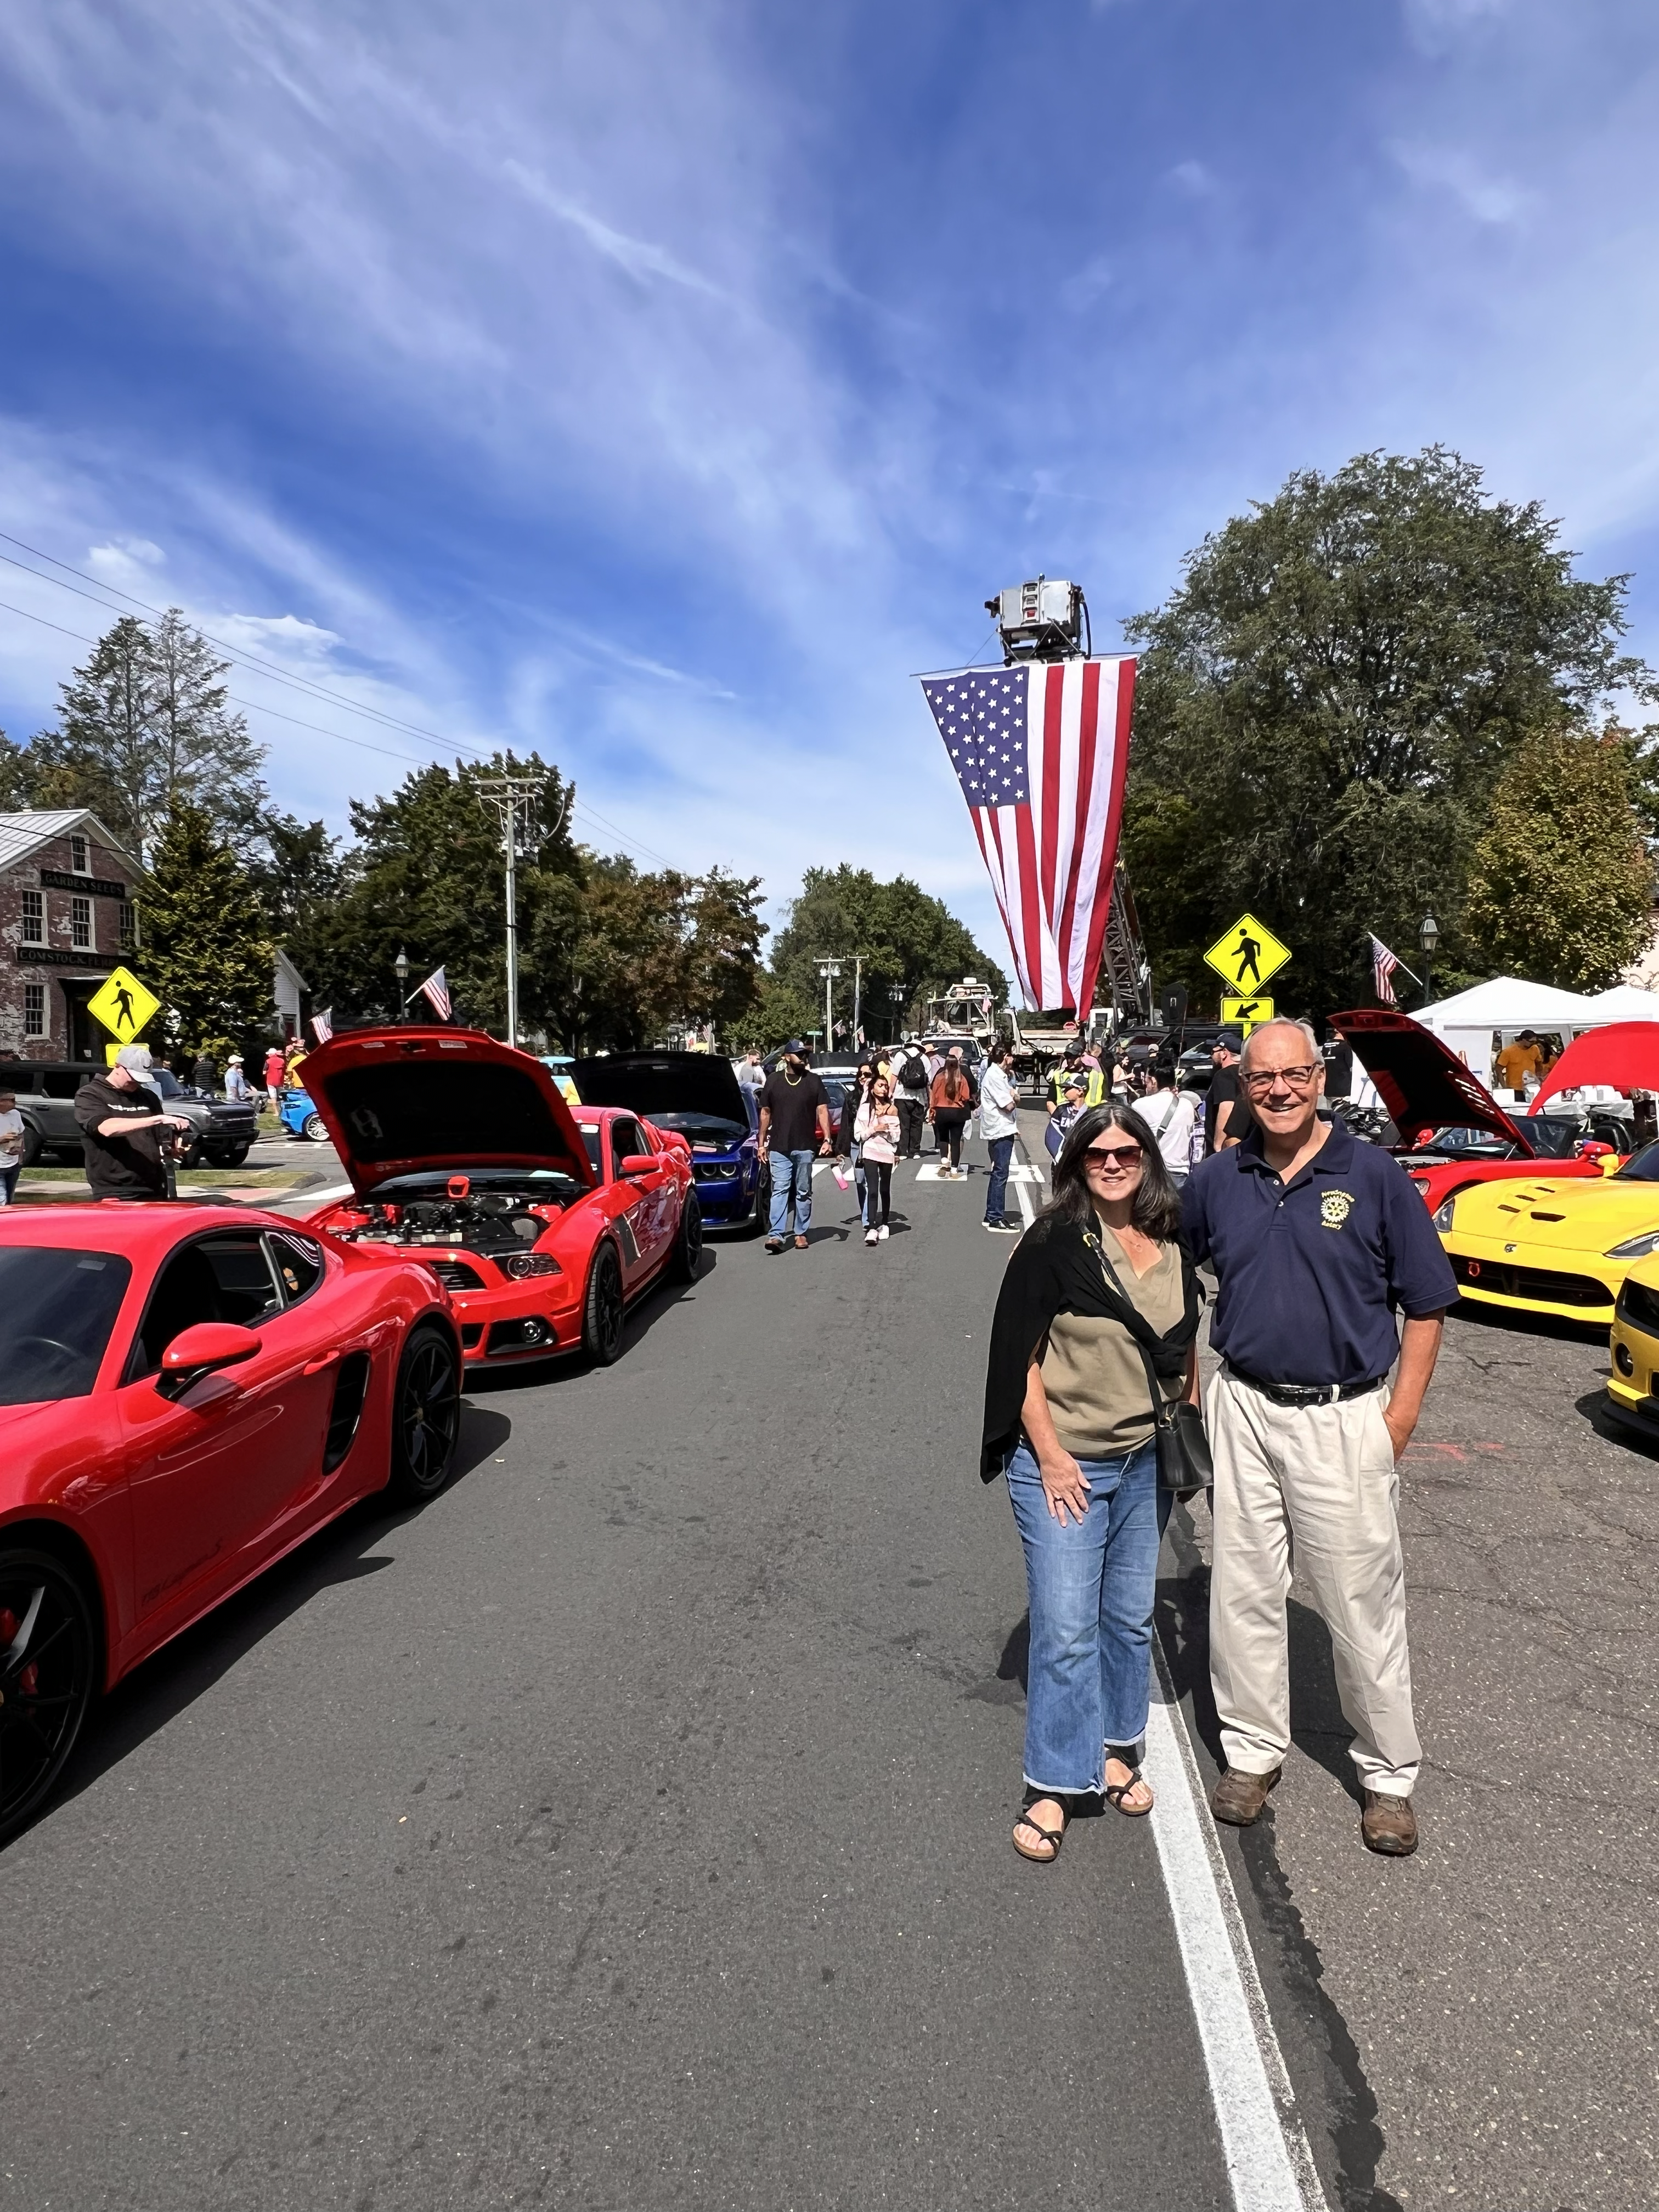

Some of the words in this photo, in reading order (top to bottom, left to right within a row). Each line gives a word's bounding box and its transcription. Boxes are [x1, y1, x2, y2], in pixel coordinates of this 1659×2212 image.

[46, 873, 88, 889] GARDEN
[91, 882, 122, 895] SEEDS
[20, 950, 86, 964] COMSTOCK
